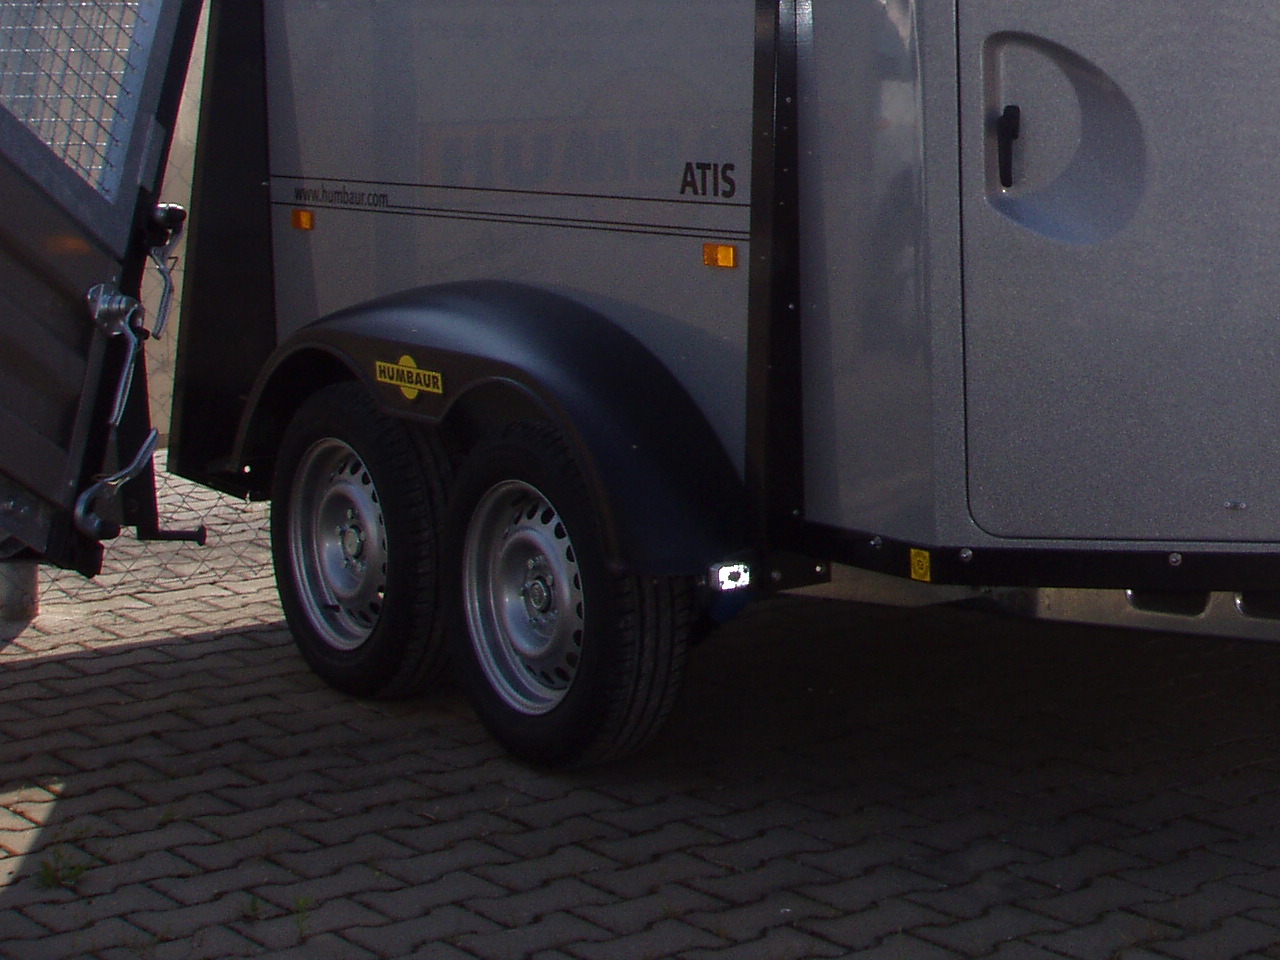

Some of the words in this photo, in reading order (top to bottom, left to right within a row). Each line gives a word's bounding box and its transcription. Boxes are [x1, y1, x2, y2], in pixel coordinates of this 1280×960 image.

[680, 162, 736, 198] ATIS
[294, 183, 388, 207] www.humbaur.com
[379, 364, 440, 390] HUMBAUR
